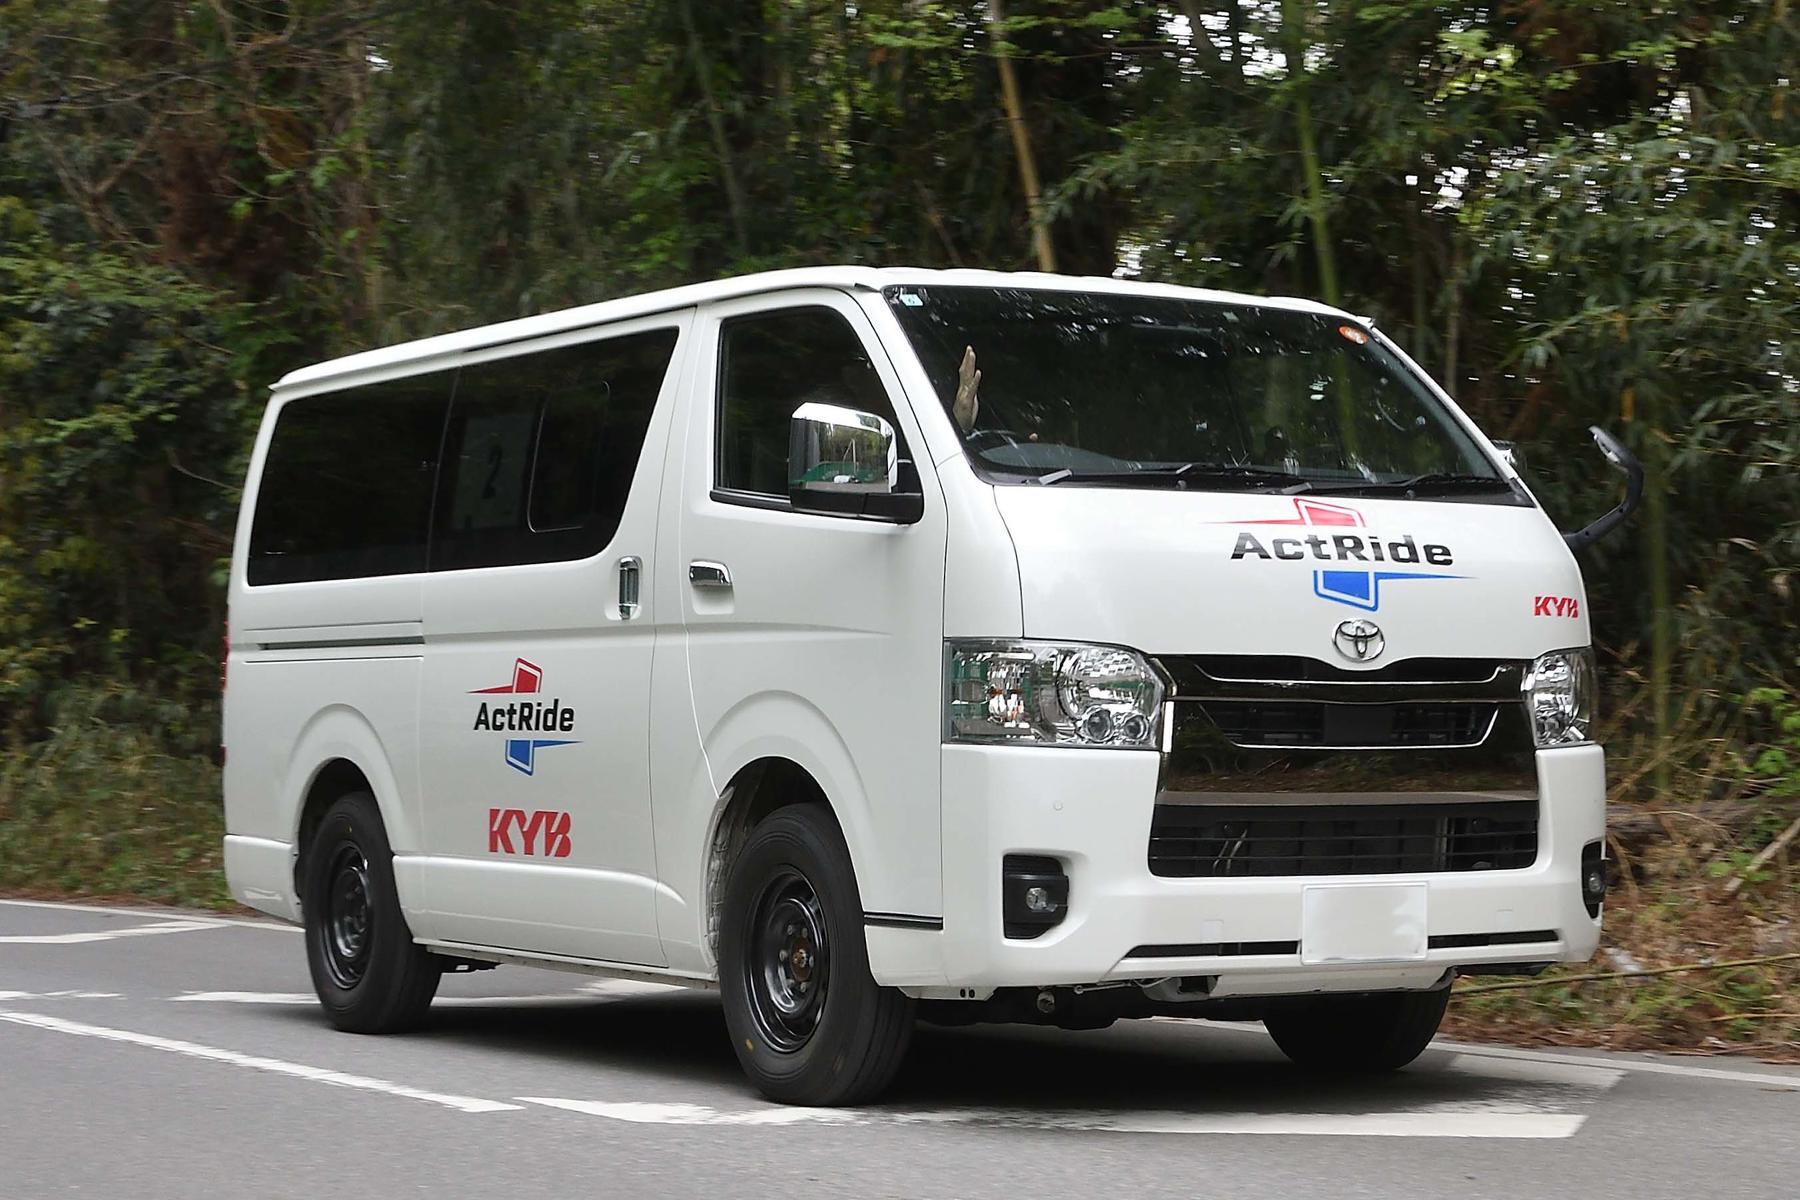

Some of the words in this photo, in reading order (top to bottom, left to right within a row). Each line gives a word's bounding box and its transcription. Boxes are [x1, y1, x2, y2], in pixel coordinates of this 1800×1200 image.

[1231, 532, 1454, 566] ActRide
[1534, 596, 1579, 619] KYB
[473, 699, 575, 732] ActRide
[488, 808, 572, 858] KYB
